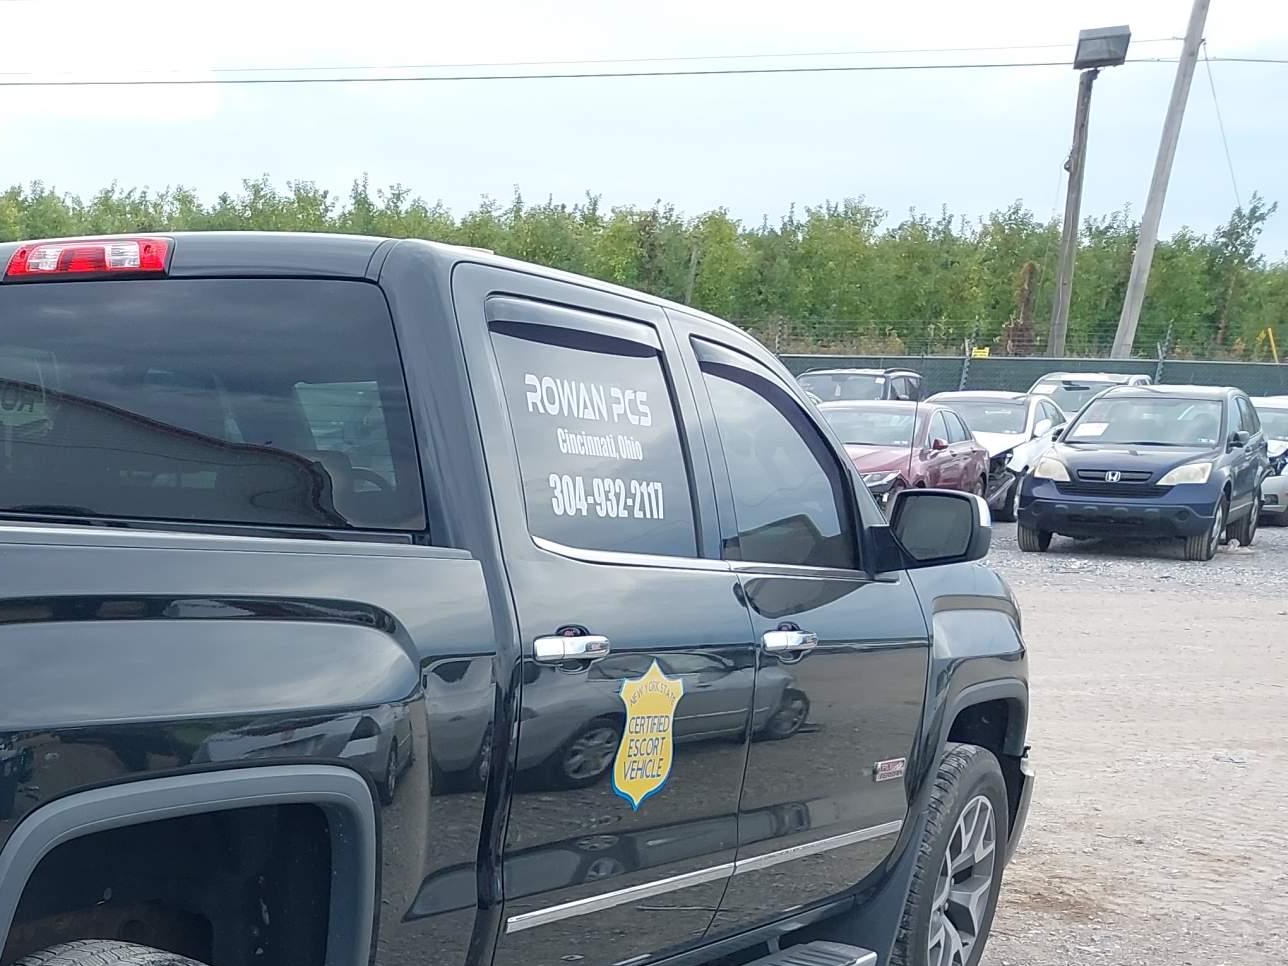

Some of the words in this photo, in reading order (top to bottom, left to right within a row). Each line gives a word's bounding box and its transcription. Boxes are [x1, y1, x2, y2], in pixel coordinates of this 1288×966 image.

[525, 374, 609, 422] ROWAN
[611, 387, 652, 427] PCS
[557, 427, 619, 460] Cincinnati,
[618, 436, 644, 461] Ohio
[549, 473, 664, 520] 304-932-2117
[628, 715, 670, 735] CERTIFIED
[627, 737, 666, 758] ESCORT
[623, 758, 664, 781] VEHICLE
